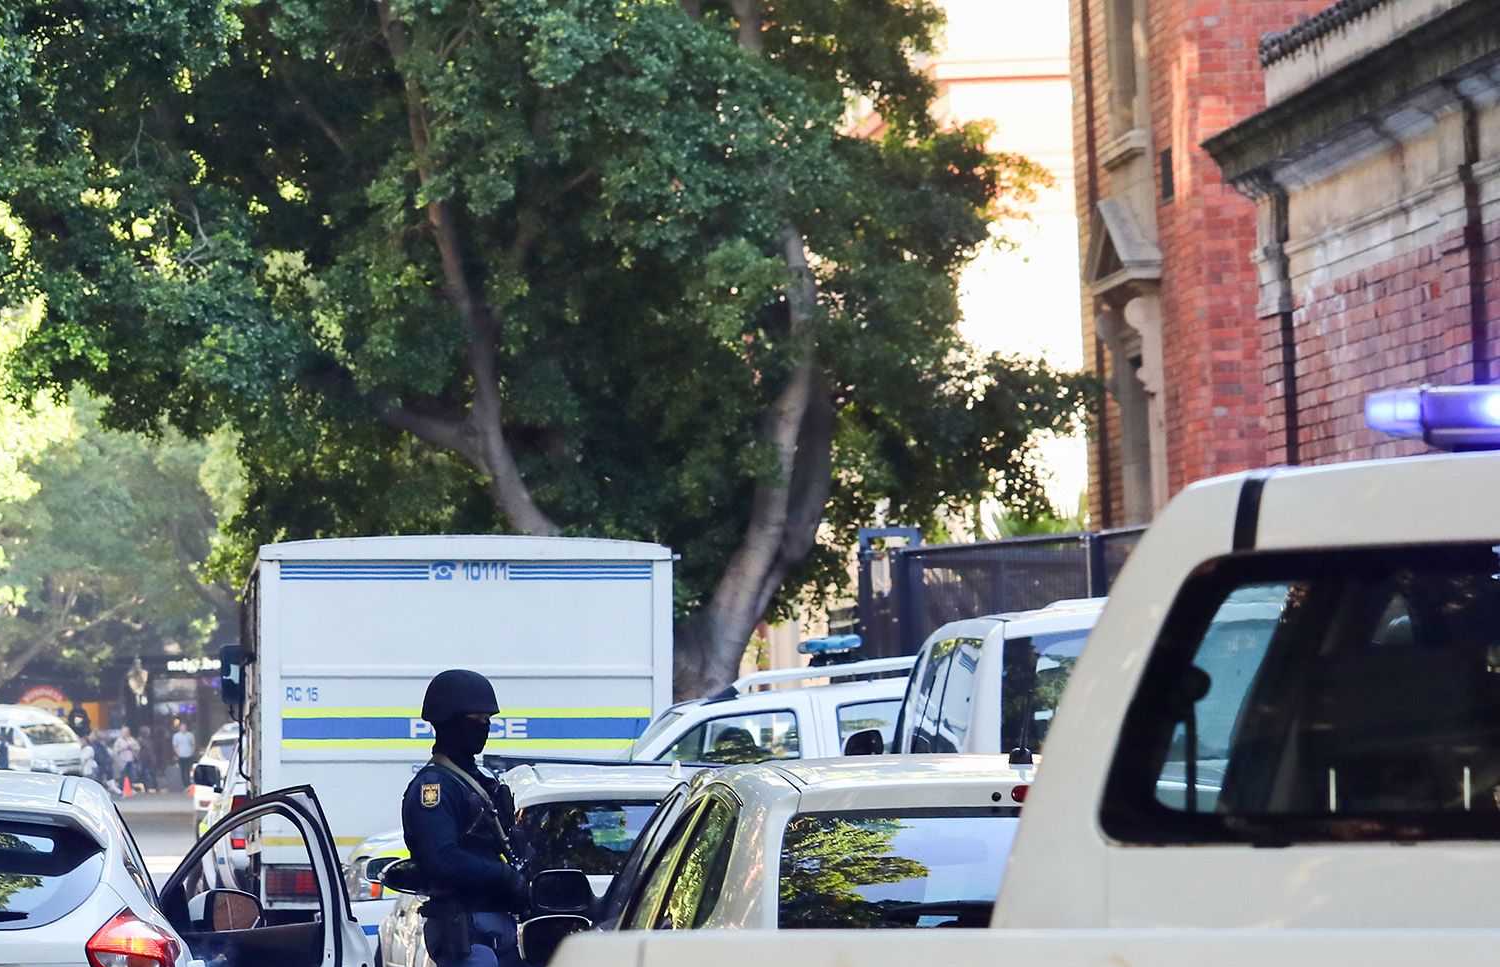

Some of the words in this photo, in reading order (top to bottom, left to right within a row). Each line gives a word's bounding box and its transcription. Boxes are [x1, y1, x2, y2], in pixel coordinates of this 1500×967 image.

[462, 562, 507, 581] 10111
[286, 687, 301, 701] RC
[306, 687, 318, 701] 15
[409, 718, 528, 738] PCE
